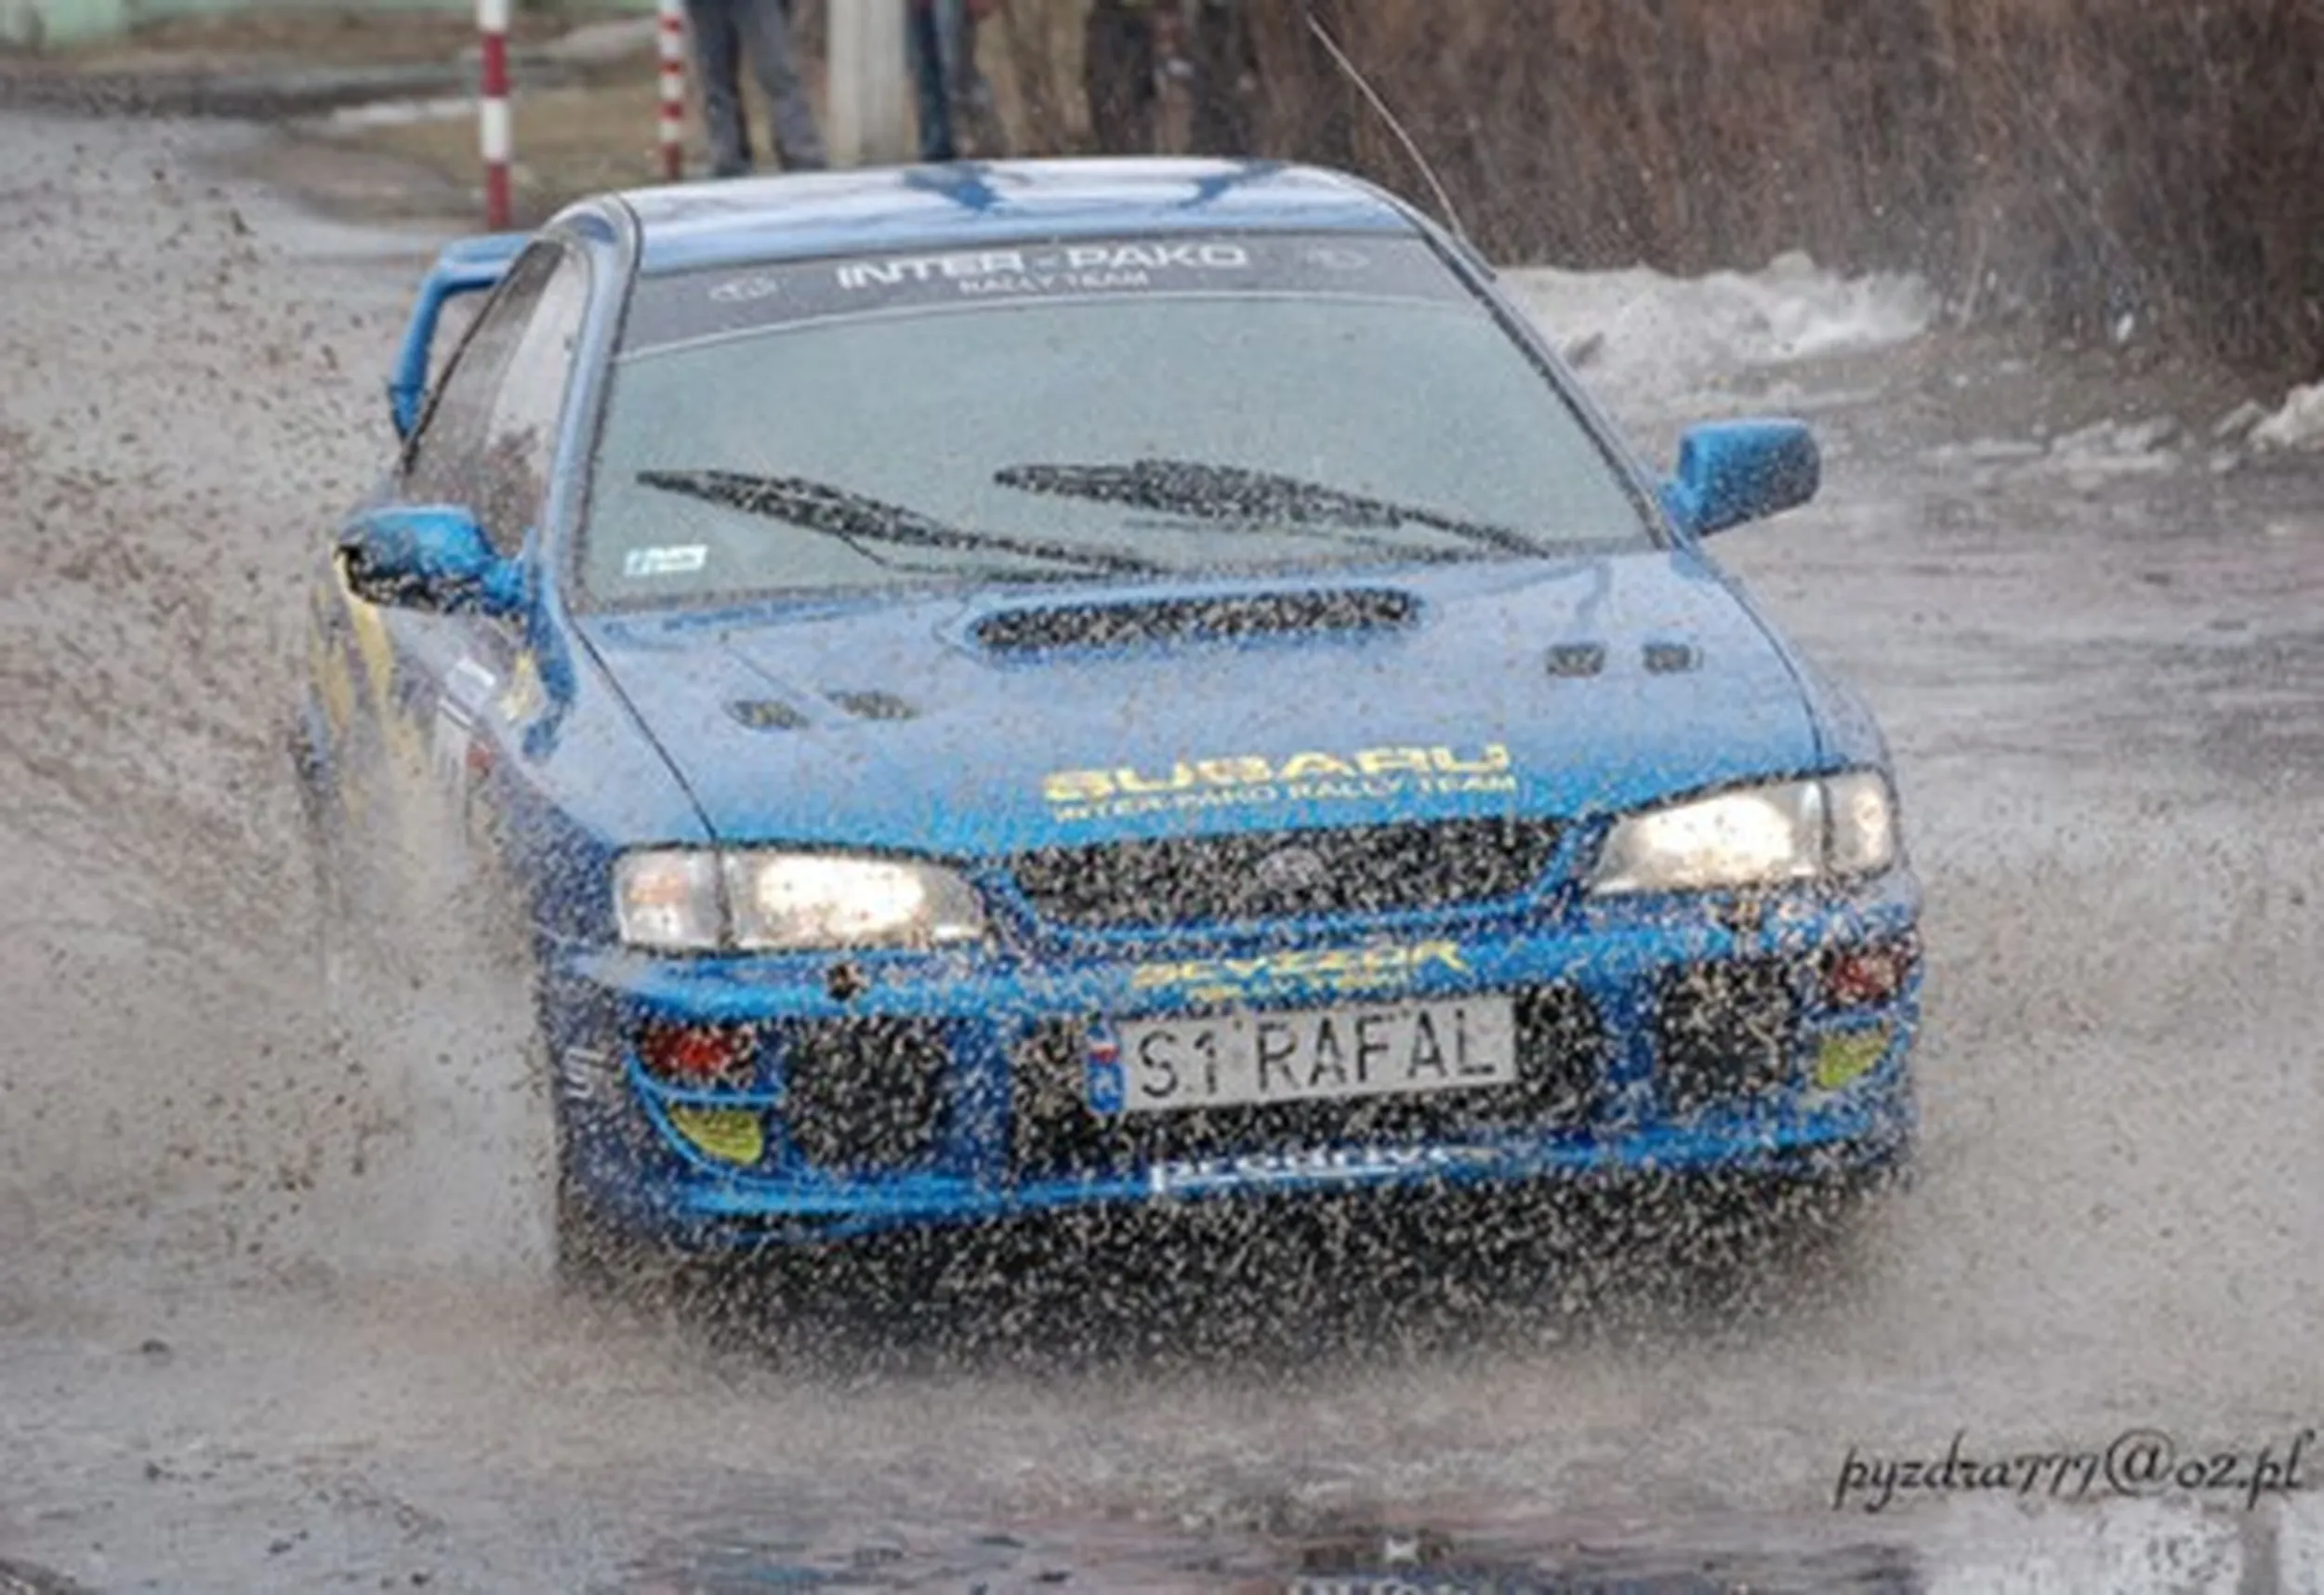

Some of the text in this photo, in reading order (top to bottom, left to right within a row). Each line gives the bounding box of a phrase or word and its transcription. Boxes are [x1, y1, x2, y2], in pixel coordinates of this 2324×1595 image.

[838, 249, 1023, 290] INTER
[1066, 244, 1249, 270] PAKO
[1065, 269, 1150, 289] TEAM
[1042, 743, 1512, 801] SUBARU
[1138, 1008, 1497, 1099] S1 RAFAL
